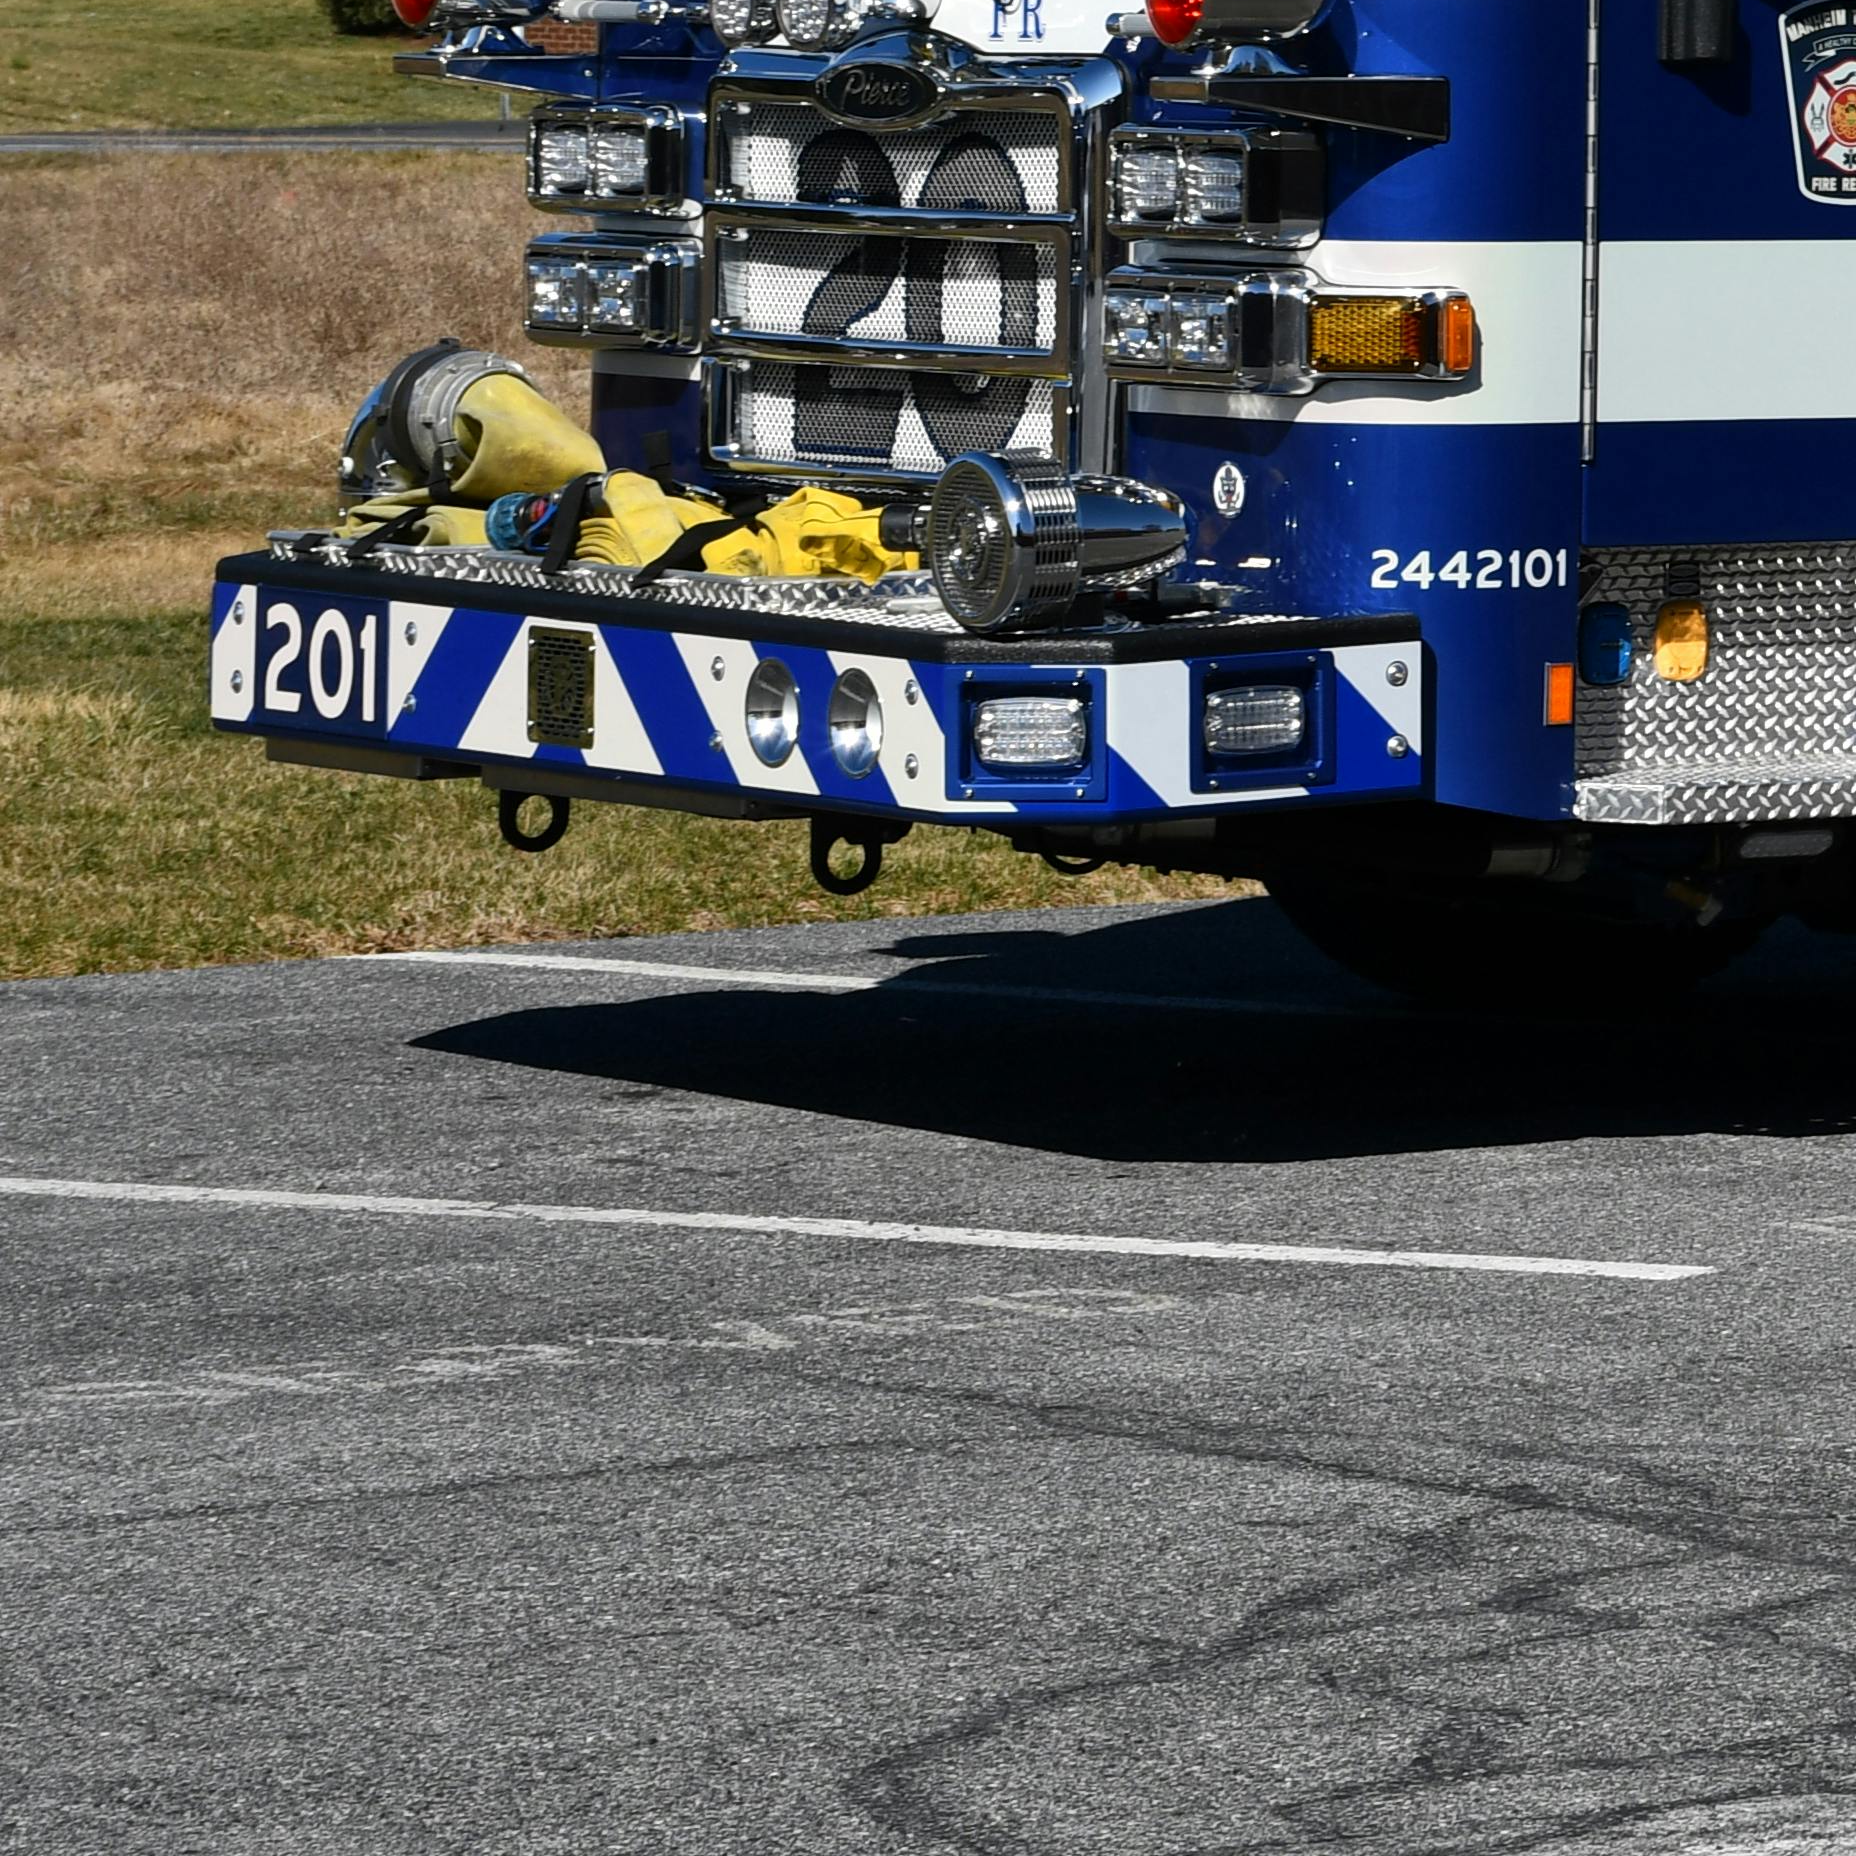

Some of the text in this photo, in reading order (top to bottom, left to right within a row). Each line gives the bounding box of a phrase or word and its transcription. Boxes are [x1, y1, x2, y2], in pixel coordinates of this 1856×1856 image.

[1786, 9, 1847, 42] MANHEIM
[1811, 177, 1837, 192] FIRE
[1370, 548, 1567, 590] 2442101
[264, 602, 377, 722] 201
